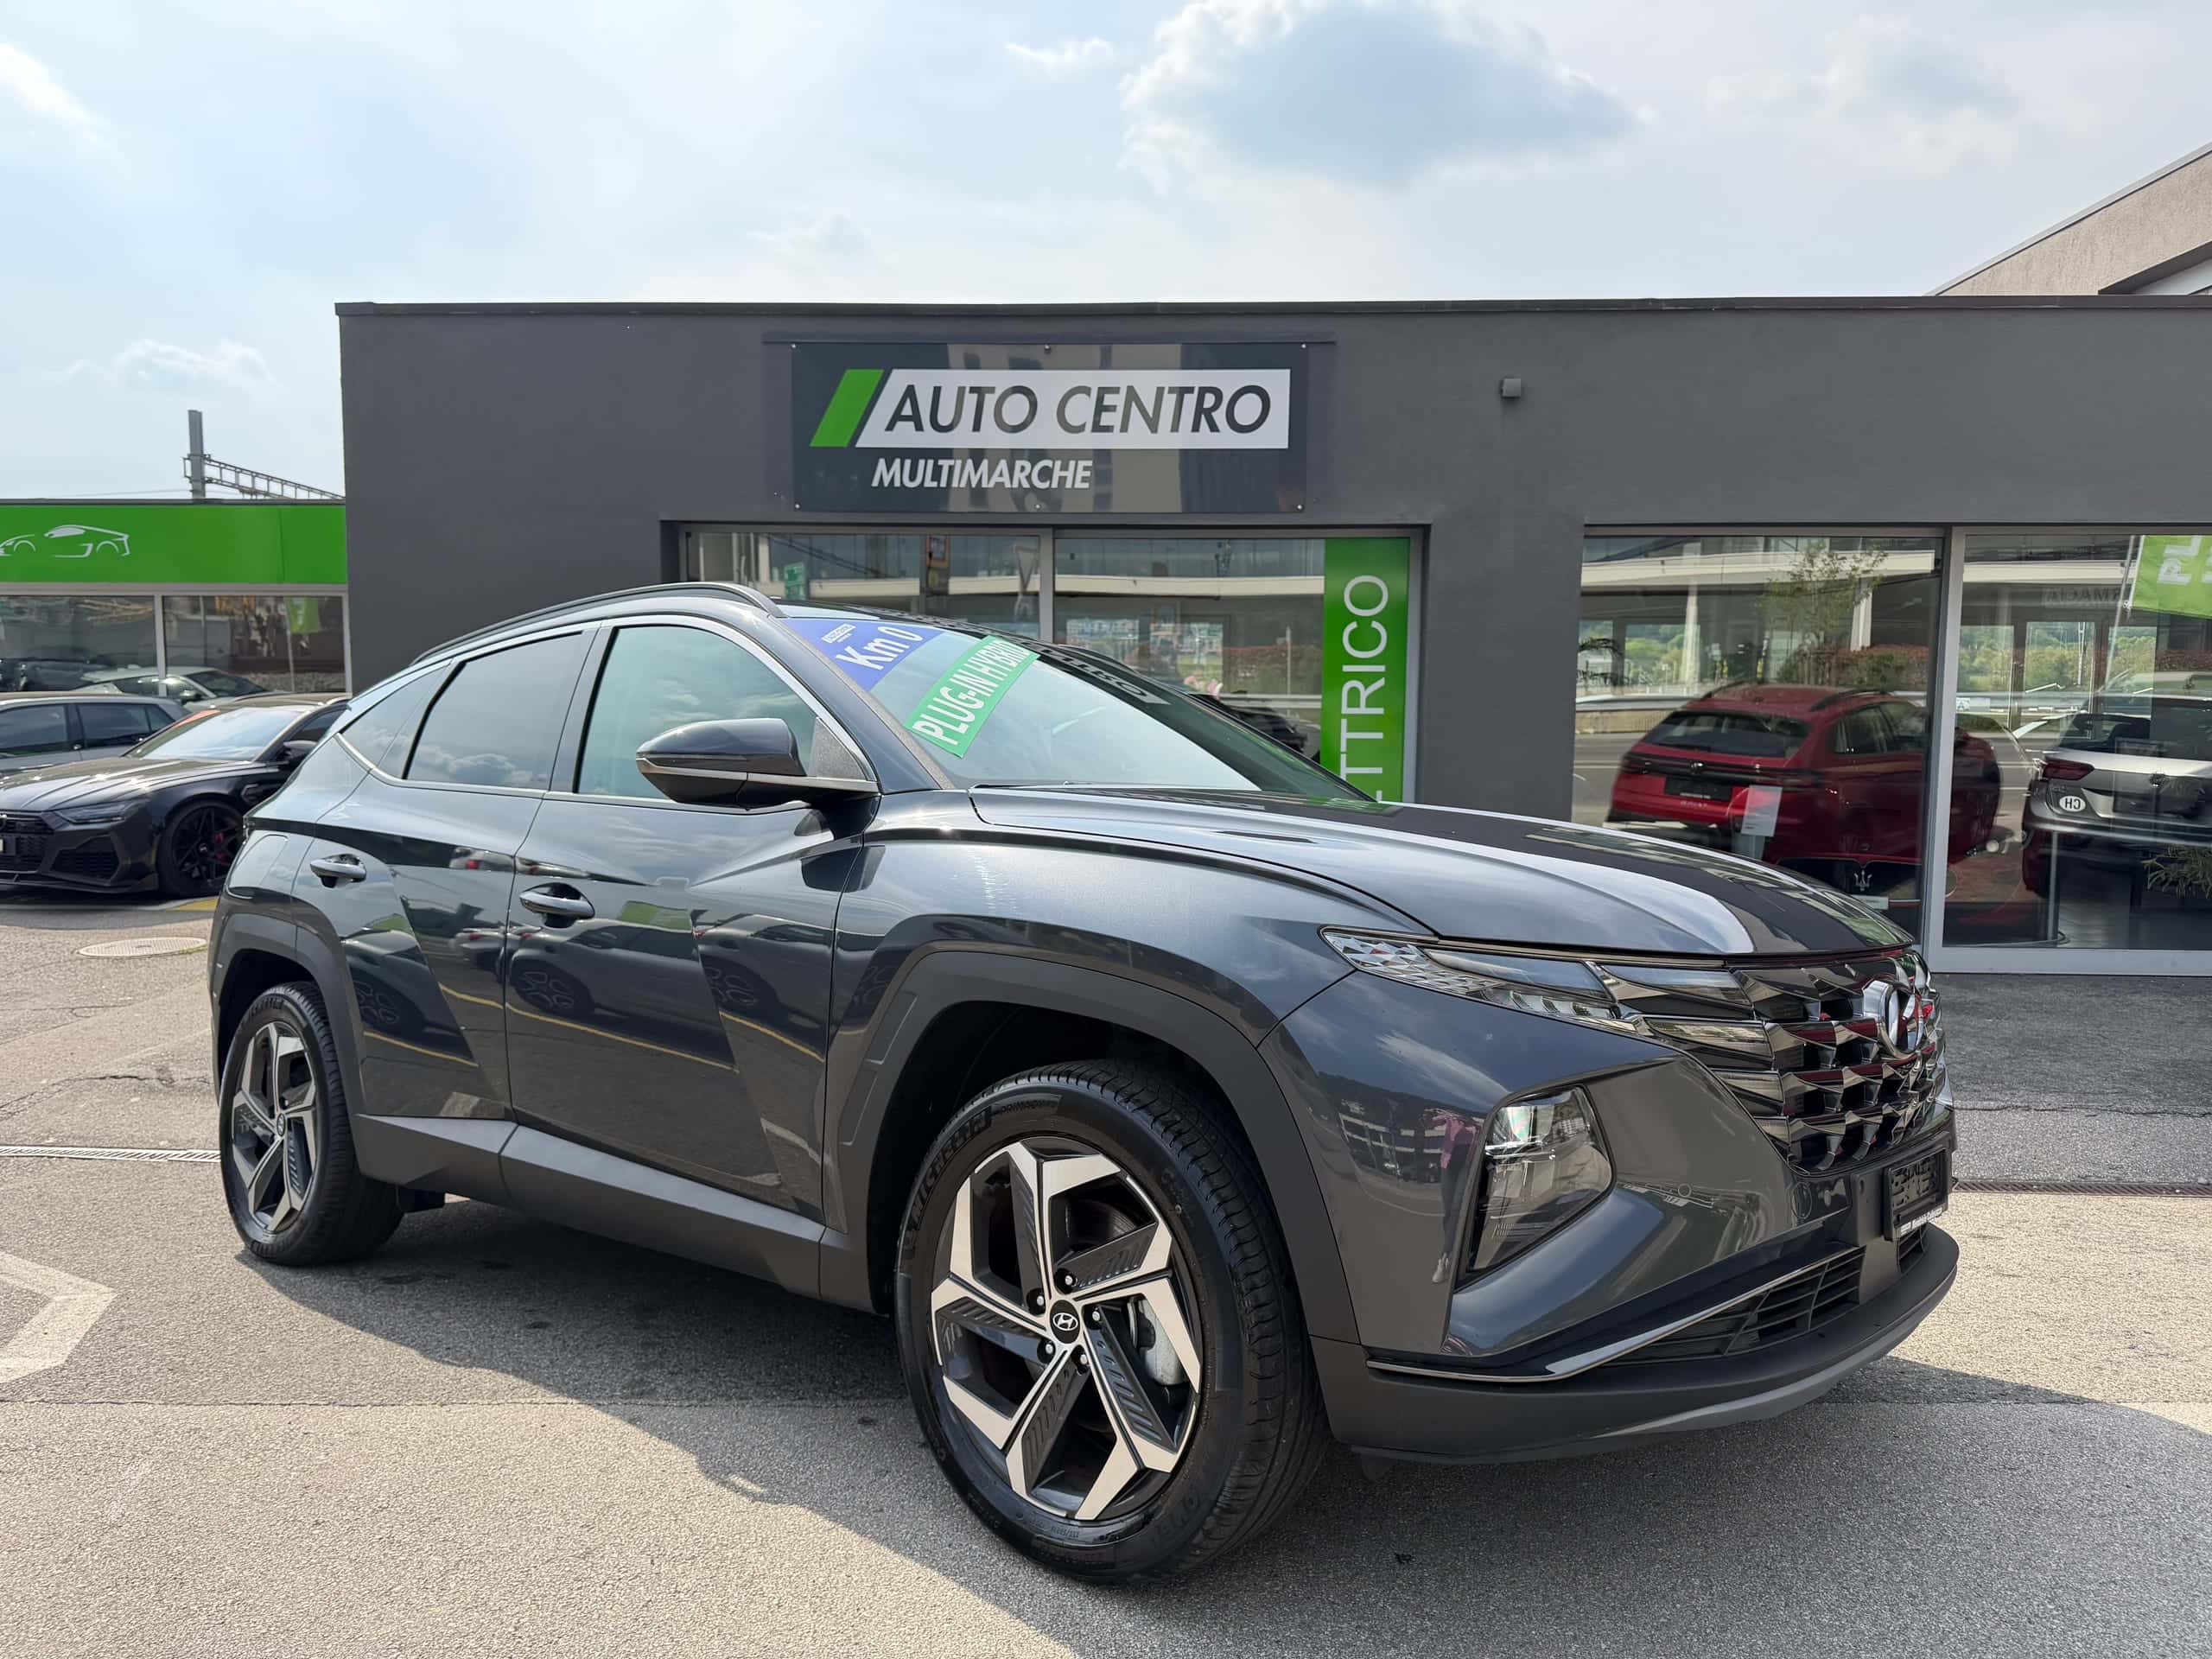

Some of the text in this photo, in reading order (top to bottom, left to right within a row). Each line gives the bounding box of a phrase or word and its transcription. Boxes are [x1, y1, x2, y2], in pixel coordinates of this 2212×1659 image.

[884, 384, 1271, 434] AUTO CENTRO
[871, 457, 1093, 489] MULTIMARCHE
[836, 638, 910, 671] Km
[877, 626, 924, 641] 0
[912, 639, 1032, 746] PLUG-IN HYBRID
[1340, 575, 1389, 802] TTRICO
